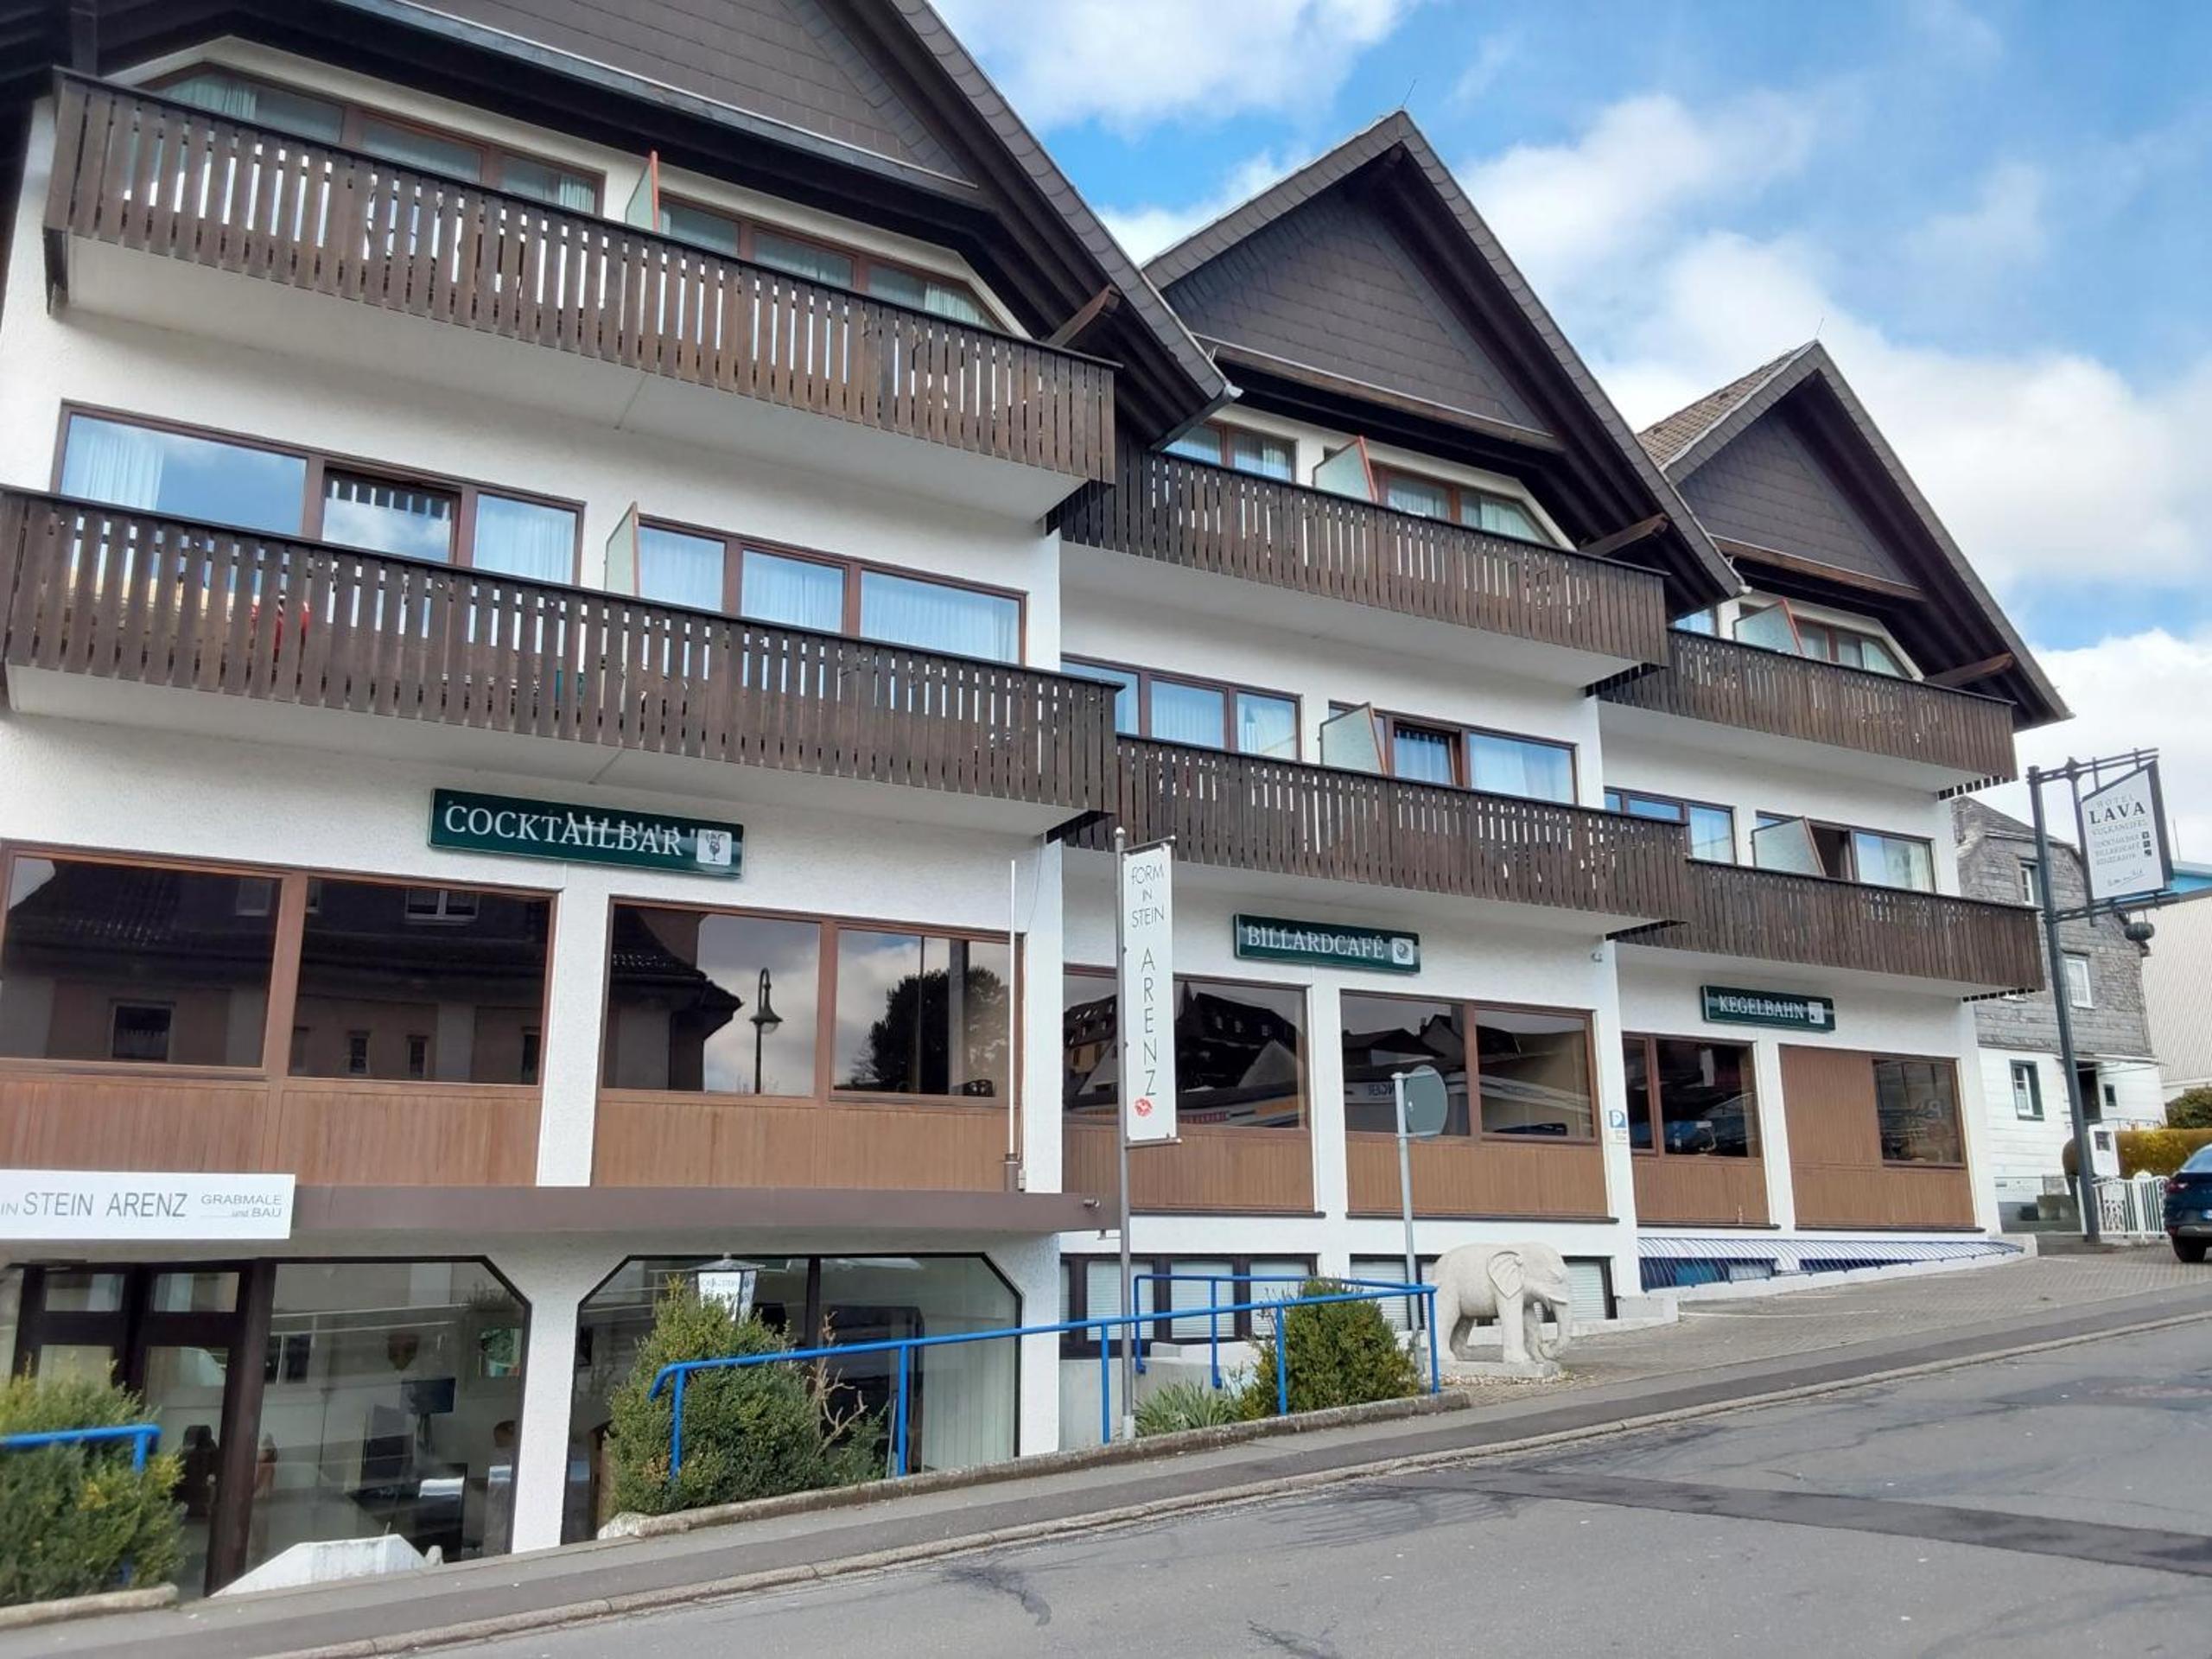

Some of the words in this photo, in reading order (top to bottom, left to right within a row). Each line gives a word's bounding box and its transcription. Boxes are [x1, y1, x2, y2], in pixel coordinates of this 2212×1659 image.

[2089, 801, 2145, 824] LAVA
[444, 804, 683, 856] COCKTAILBAR
[1132, 863, 1164, 885] FORM
[1132, 905, 1165, 928] STEIN
[1247, 925, 1384, 959] BILLARDCAFÉ
[1718, 995, 1805, 1020] KEGELBAHN
[1141, 948, 1158, 1096] ARENZ
[1, 1202, 18, 1216] IN
[22, 1192, 94, 1216] STEIN
[105, 1192, 188, 1217] ARENZ
[200, 1193, 283, 1206] GRABMALE
[251, 1206, 283, 1217] BAU
